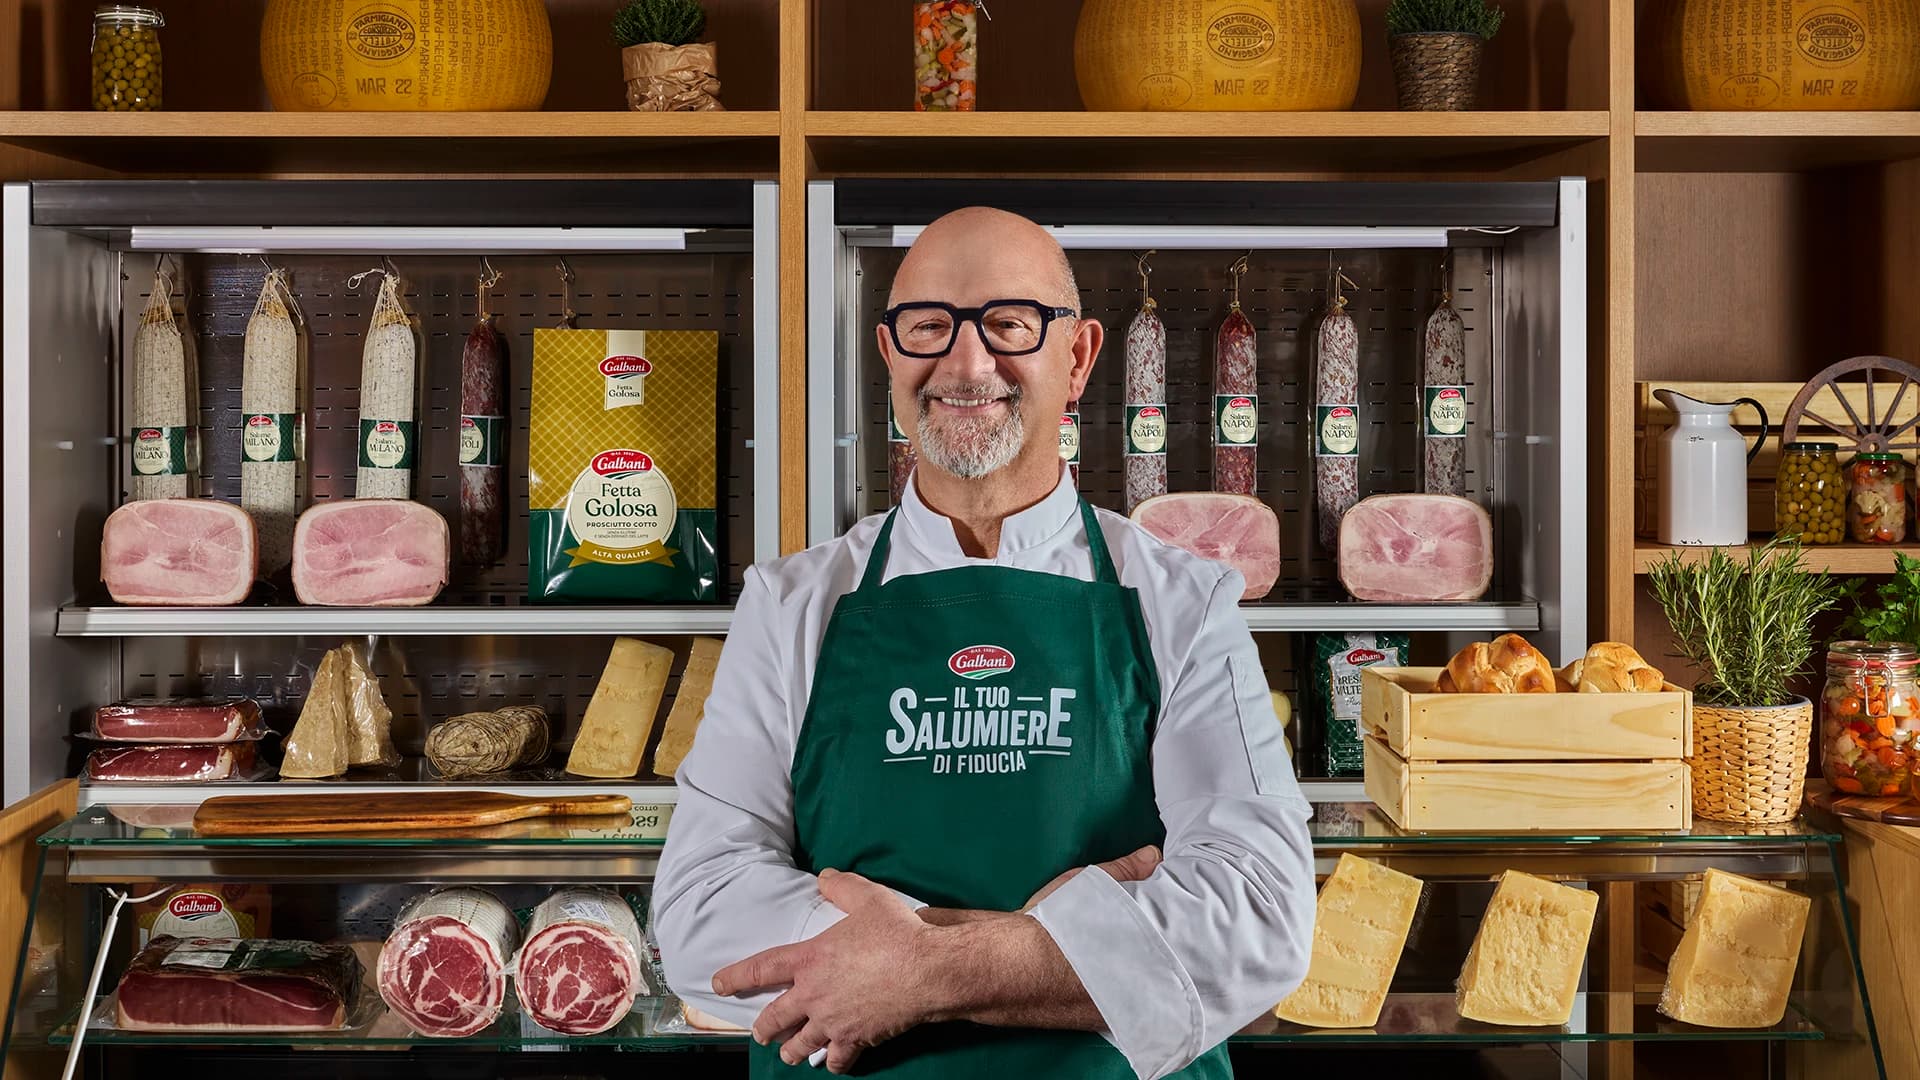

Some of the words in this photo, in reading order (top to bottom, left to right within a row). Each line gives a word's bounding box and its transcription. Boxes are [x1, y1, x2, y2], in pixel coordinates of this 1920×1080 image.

[357, 78, 386, 95] MAR
[395, 79, 412, 94] 22
[1214, 79, 1245, 96] MAR
[1253, 80, 1269, 96] 22
[1802, 79, 1834, 96] MAR
[1841, 80, 1858, 96] 22
[604, 361, 646, 372] Galbani
[608, 390, 640, 398] Golosa
[1433, 411, 1464, 419] NAPOLI
[1224, 420, 1255, 428] NAPOLI
[1134, 429, 1164, 437] NAPOLI
[1325, 430, 1356, 438] NAPOLI
[245, 438, 279, 446] MILANO
[370, 444, 403, 452] MILANO
[136, 451, 168, 459] MILANO
[597, 457, 646, 470] Galbani
[602, 483, 641, 497] Fetta
[585, 498, 658, 517] Golosa
[592, 549, 613, 558] ALTA
[956, 654, 1007, 669] Galbani
[1351, 653, 1381, 662] Galbani
[953, 686, 970, 708] IL
[975, 686, 1010, 708] TUO
[886, 687, 1077, 755] SALUMIERE
[932, 754, 950, 774] DI
[957, 750, 1026, 774] FIDUCIA
[173, 899, 217, 912] Galbani
